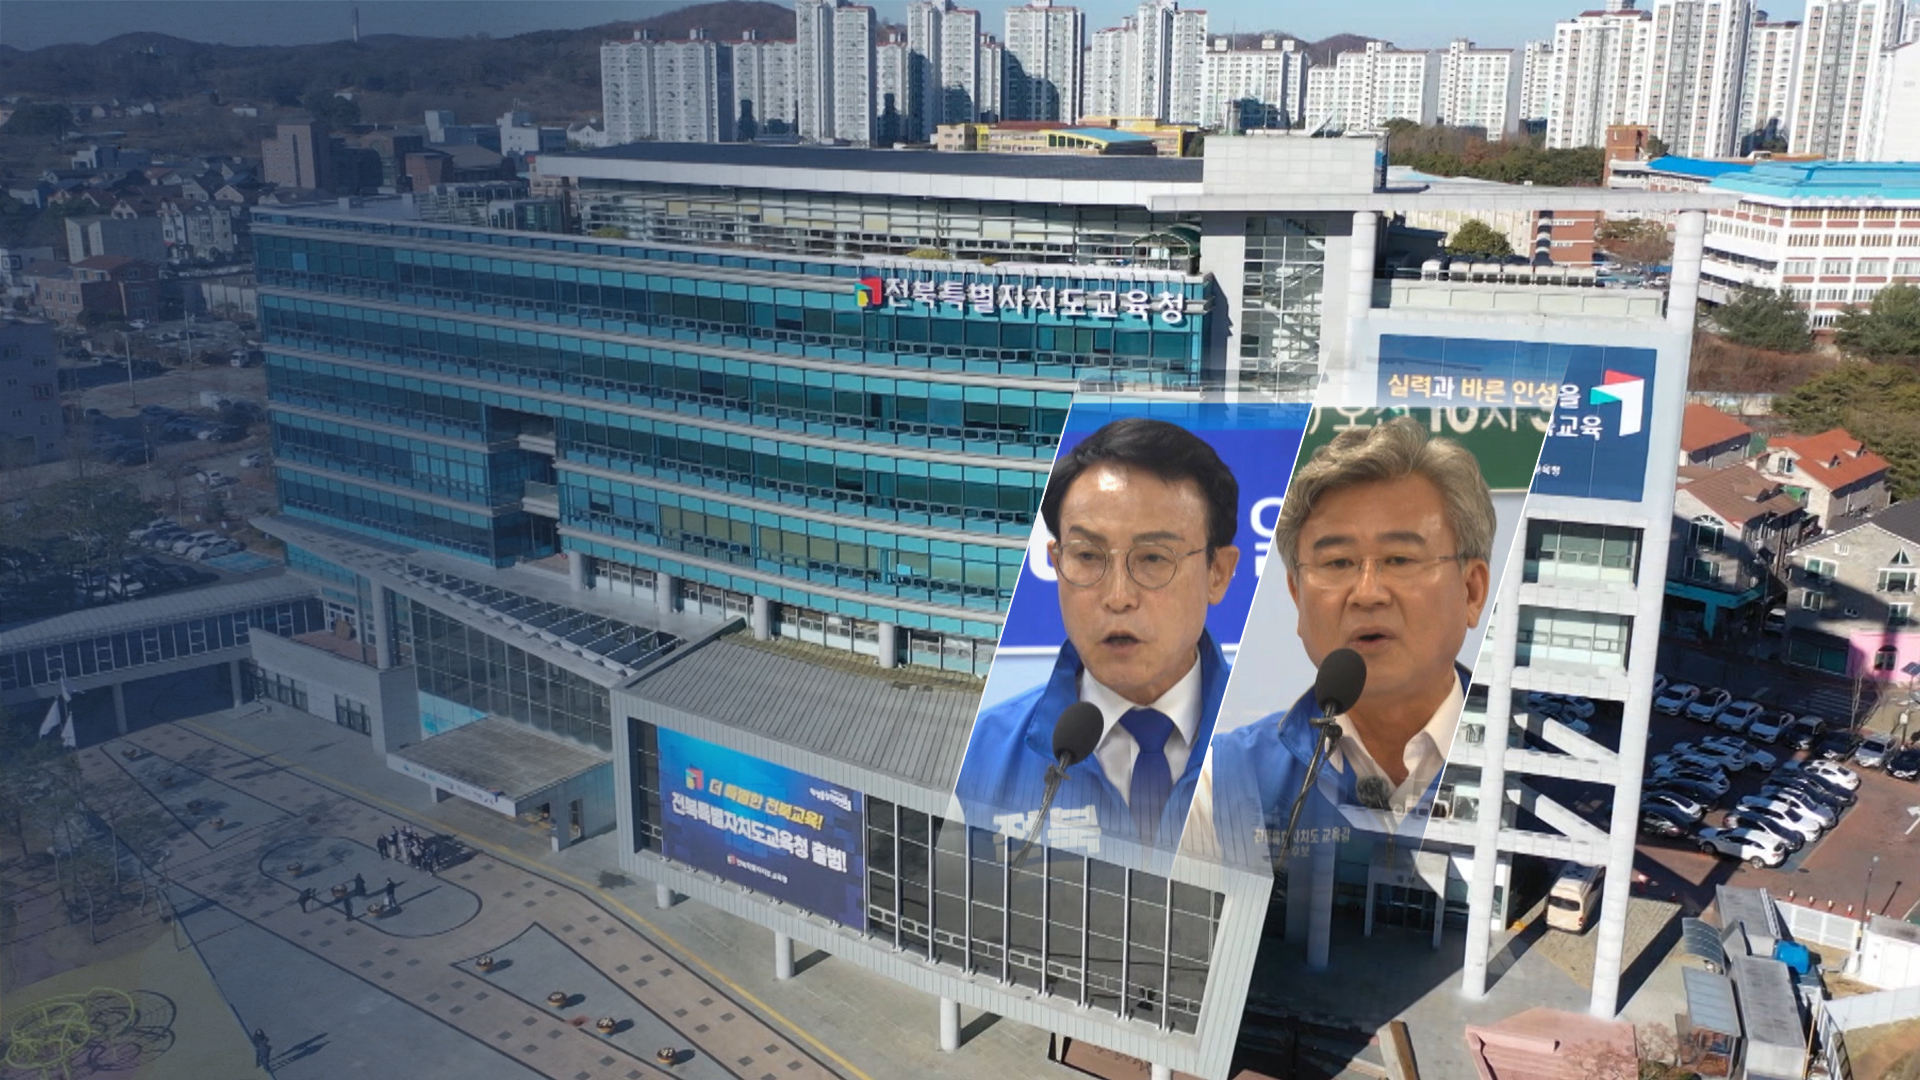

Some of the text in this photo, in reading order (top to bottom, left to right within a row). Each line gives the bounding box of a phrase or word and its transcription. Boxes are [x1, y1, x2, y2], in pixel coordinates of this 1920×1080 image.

[885, 277, 1185, 324] 전북특별자치도교육청
[1388, 374, 1582, 410] 실력과 바른 인성을
[709, 778, 723, 796] 더
[765, 797, 824, 831] 전북교육!
[671, 791, 809, 860] 전북특별자치도교육청
[811, 841, 848, 873] 출범!
